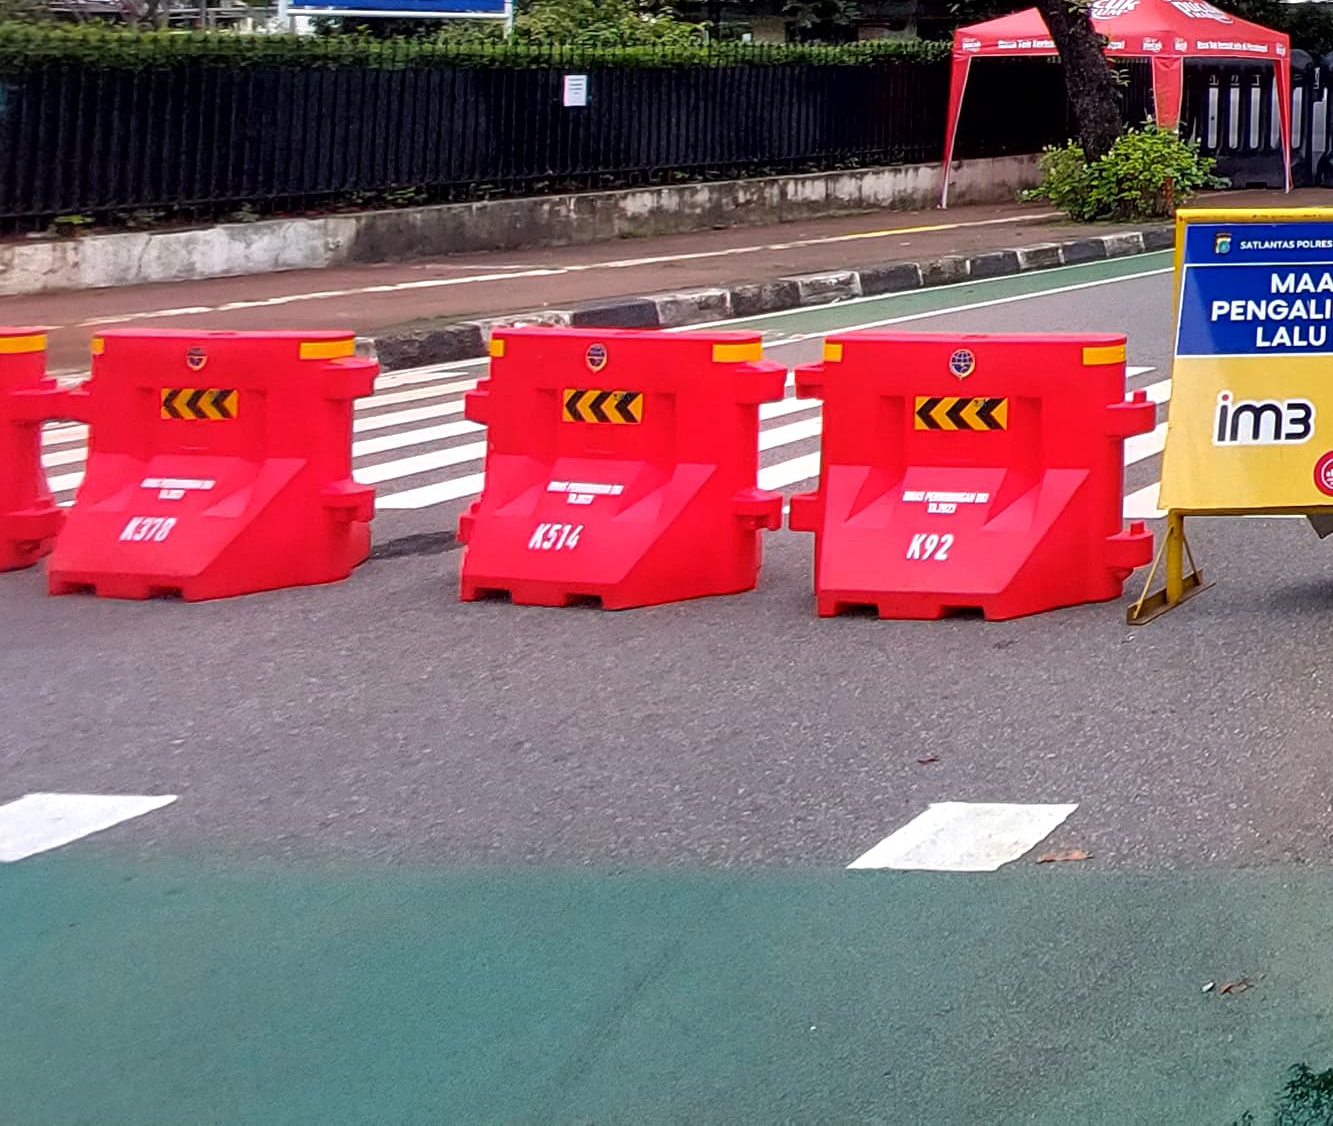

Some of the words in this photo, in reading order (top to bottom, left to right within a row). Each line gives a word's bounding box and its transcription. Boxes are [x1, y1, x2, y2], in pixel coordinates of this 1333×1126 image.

[1240, 240, 1295, 250] SATLANTAS
[1297, 239, 1333, 249] POLRES
[1256, 324, 1326, 348] LALU
[1216, 391, 1313, 443] im3
[528, 523, 584, 550] K514
[906, 533, 955, 561] K92
